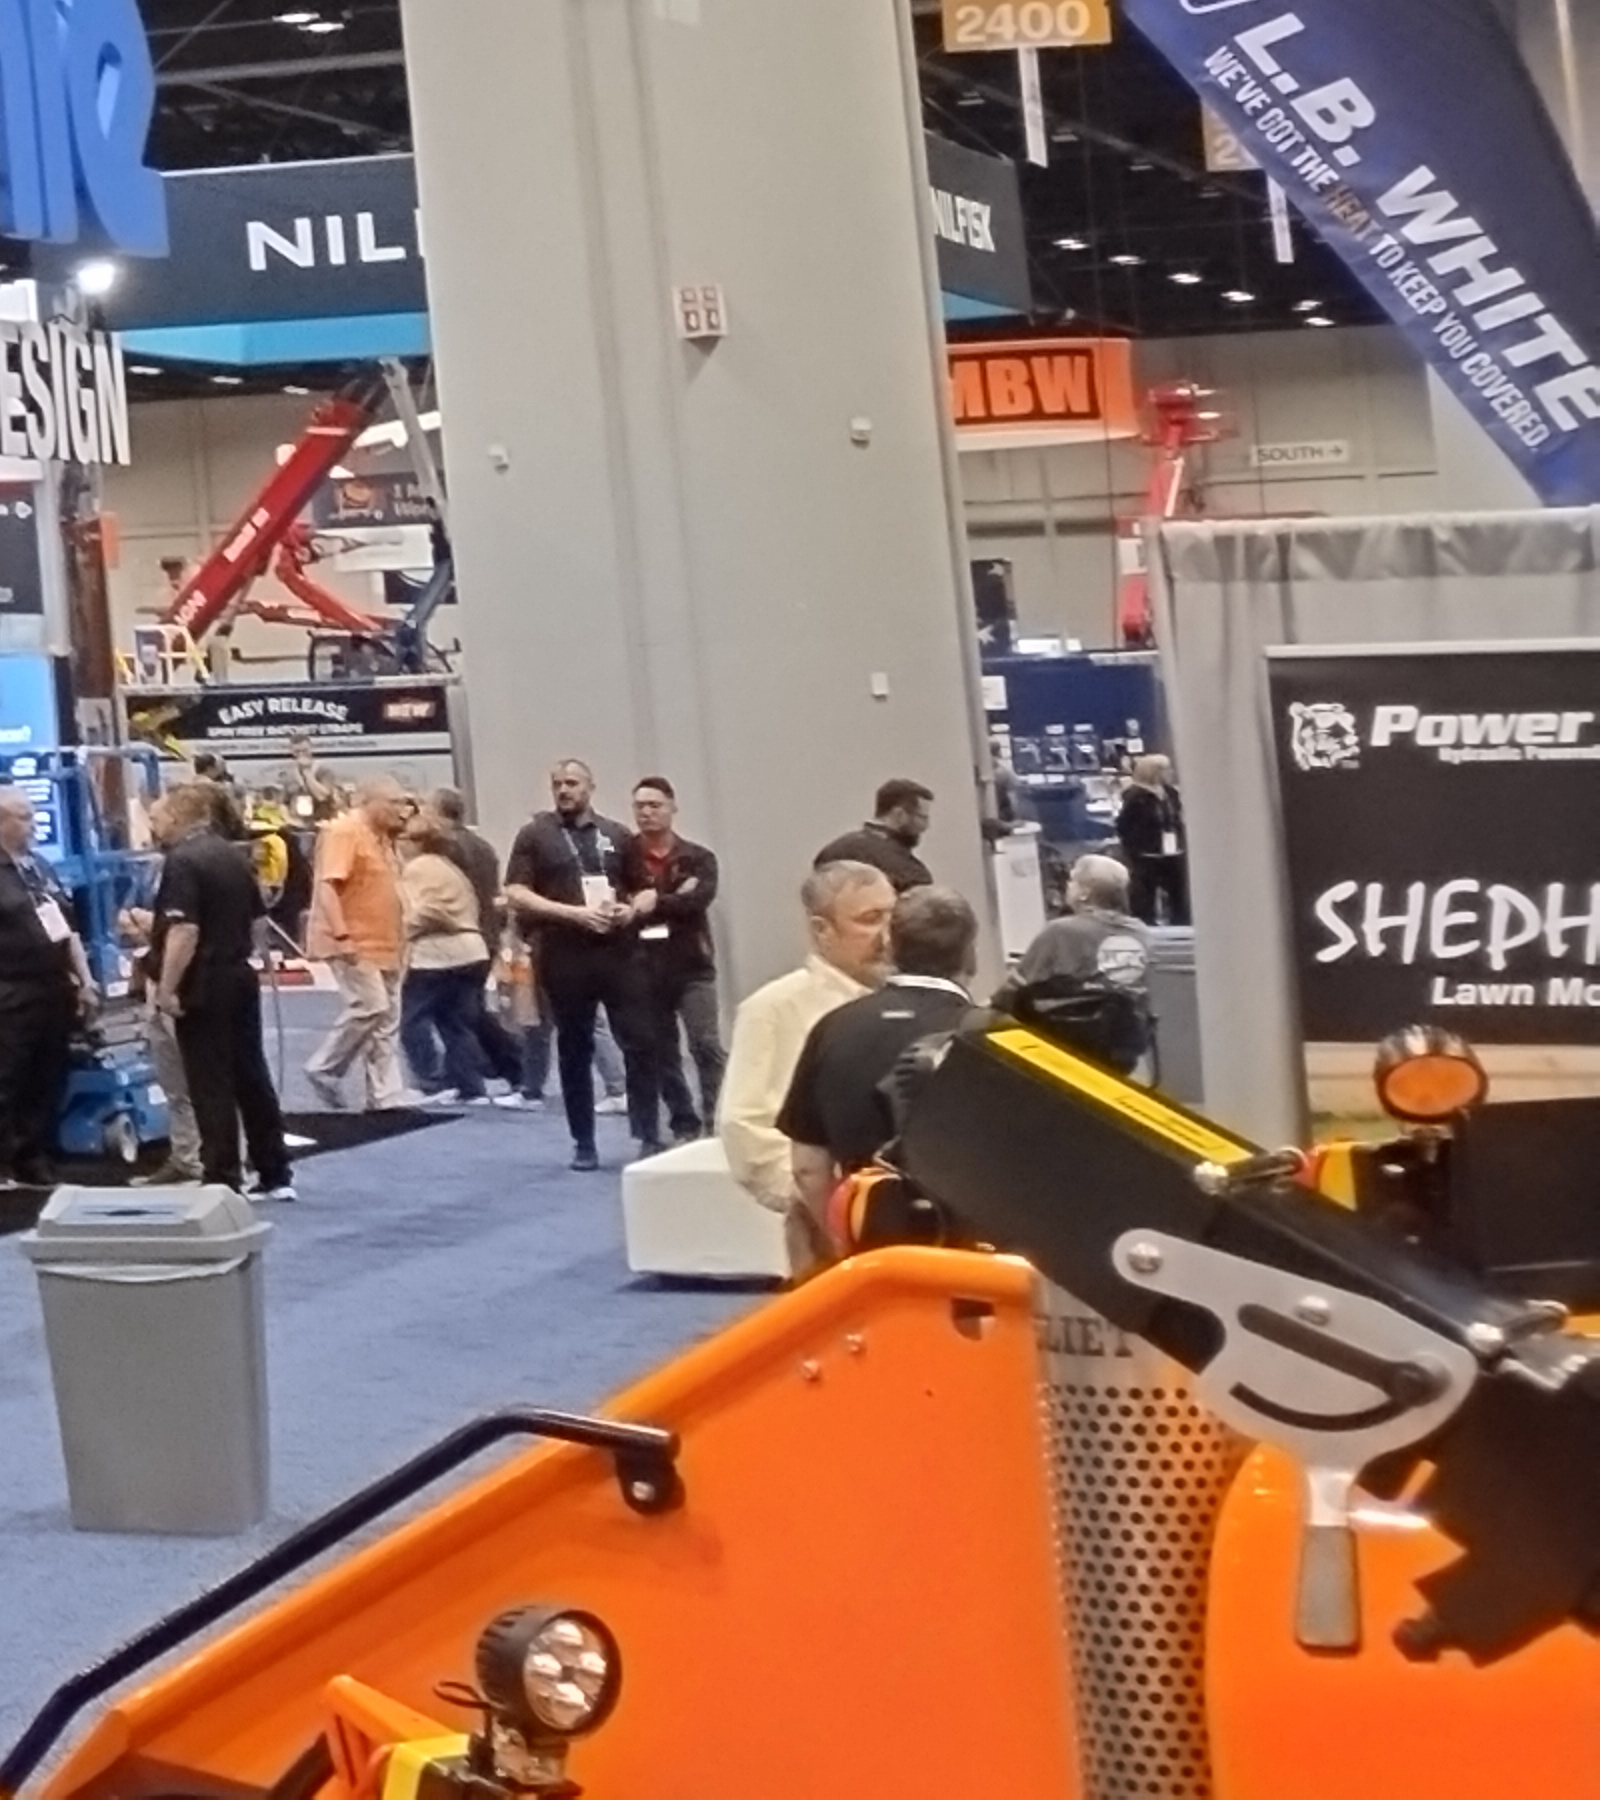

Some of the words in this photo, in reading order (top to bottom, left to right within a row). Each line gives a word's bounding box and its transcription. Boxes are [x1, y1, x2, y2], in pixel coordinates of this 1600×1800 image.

[956, 2, 1091, 43] 2400
[1203, 47, 1255, 122] WE'VE
[1256, 106, 1300, 164] GOT
[1291, 142, 1341, 193] THE
[1324, 184, 1377, 243] HEAT
[1369, 231, 1402, 271] TO
[1391, 257, 1445, 319] KEEP
[1431, 312, 1474, 362] YOU
[247, 211, 423, 271] NIL
[1376, 165, 1600, 433] WHITE
[950, 355, 1095, 417] MBW
[1258, 447, 1324, 463] SOUTH
[218, 699, 265, 725] EASY
[267, 696, 350, 721] RELEASE
[1371, 705, 1595, 748] Power
[1432, 977, 1536, 1006] Lawn
